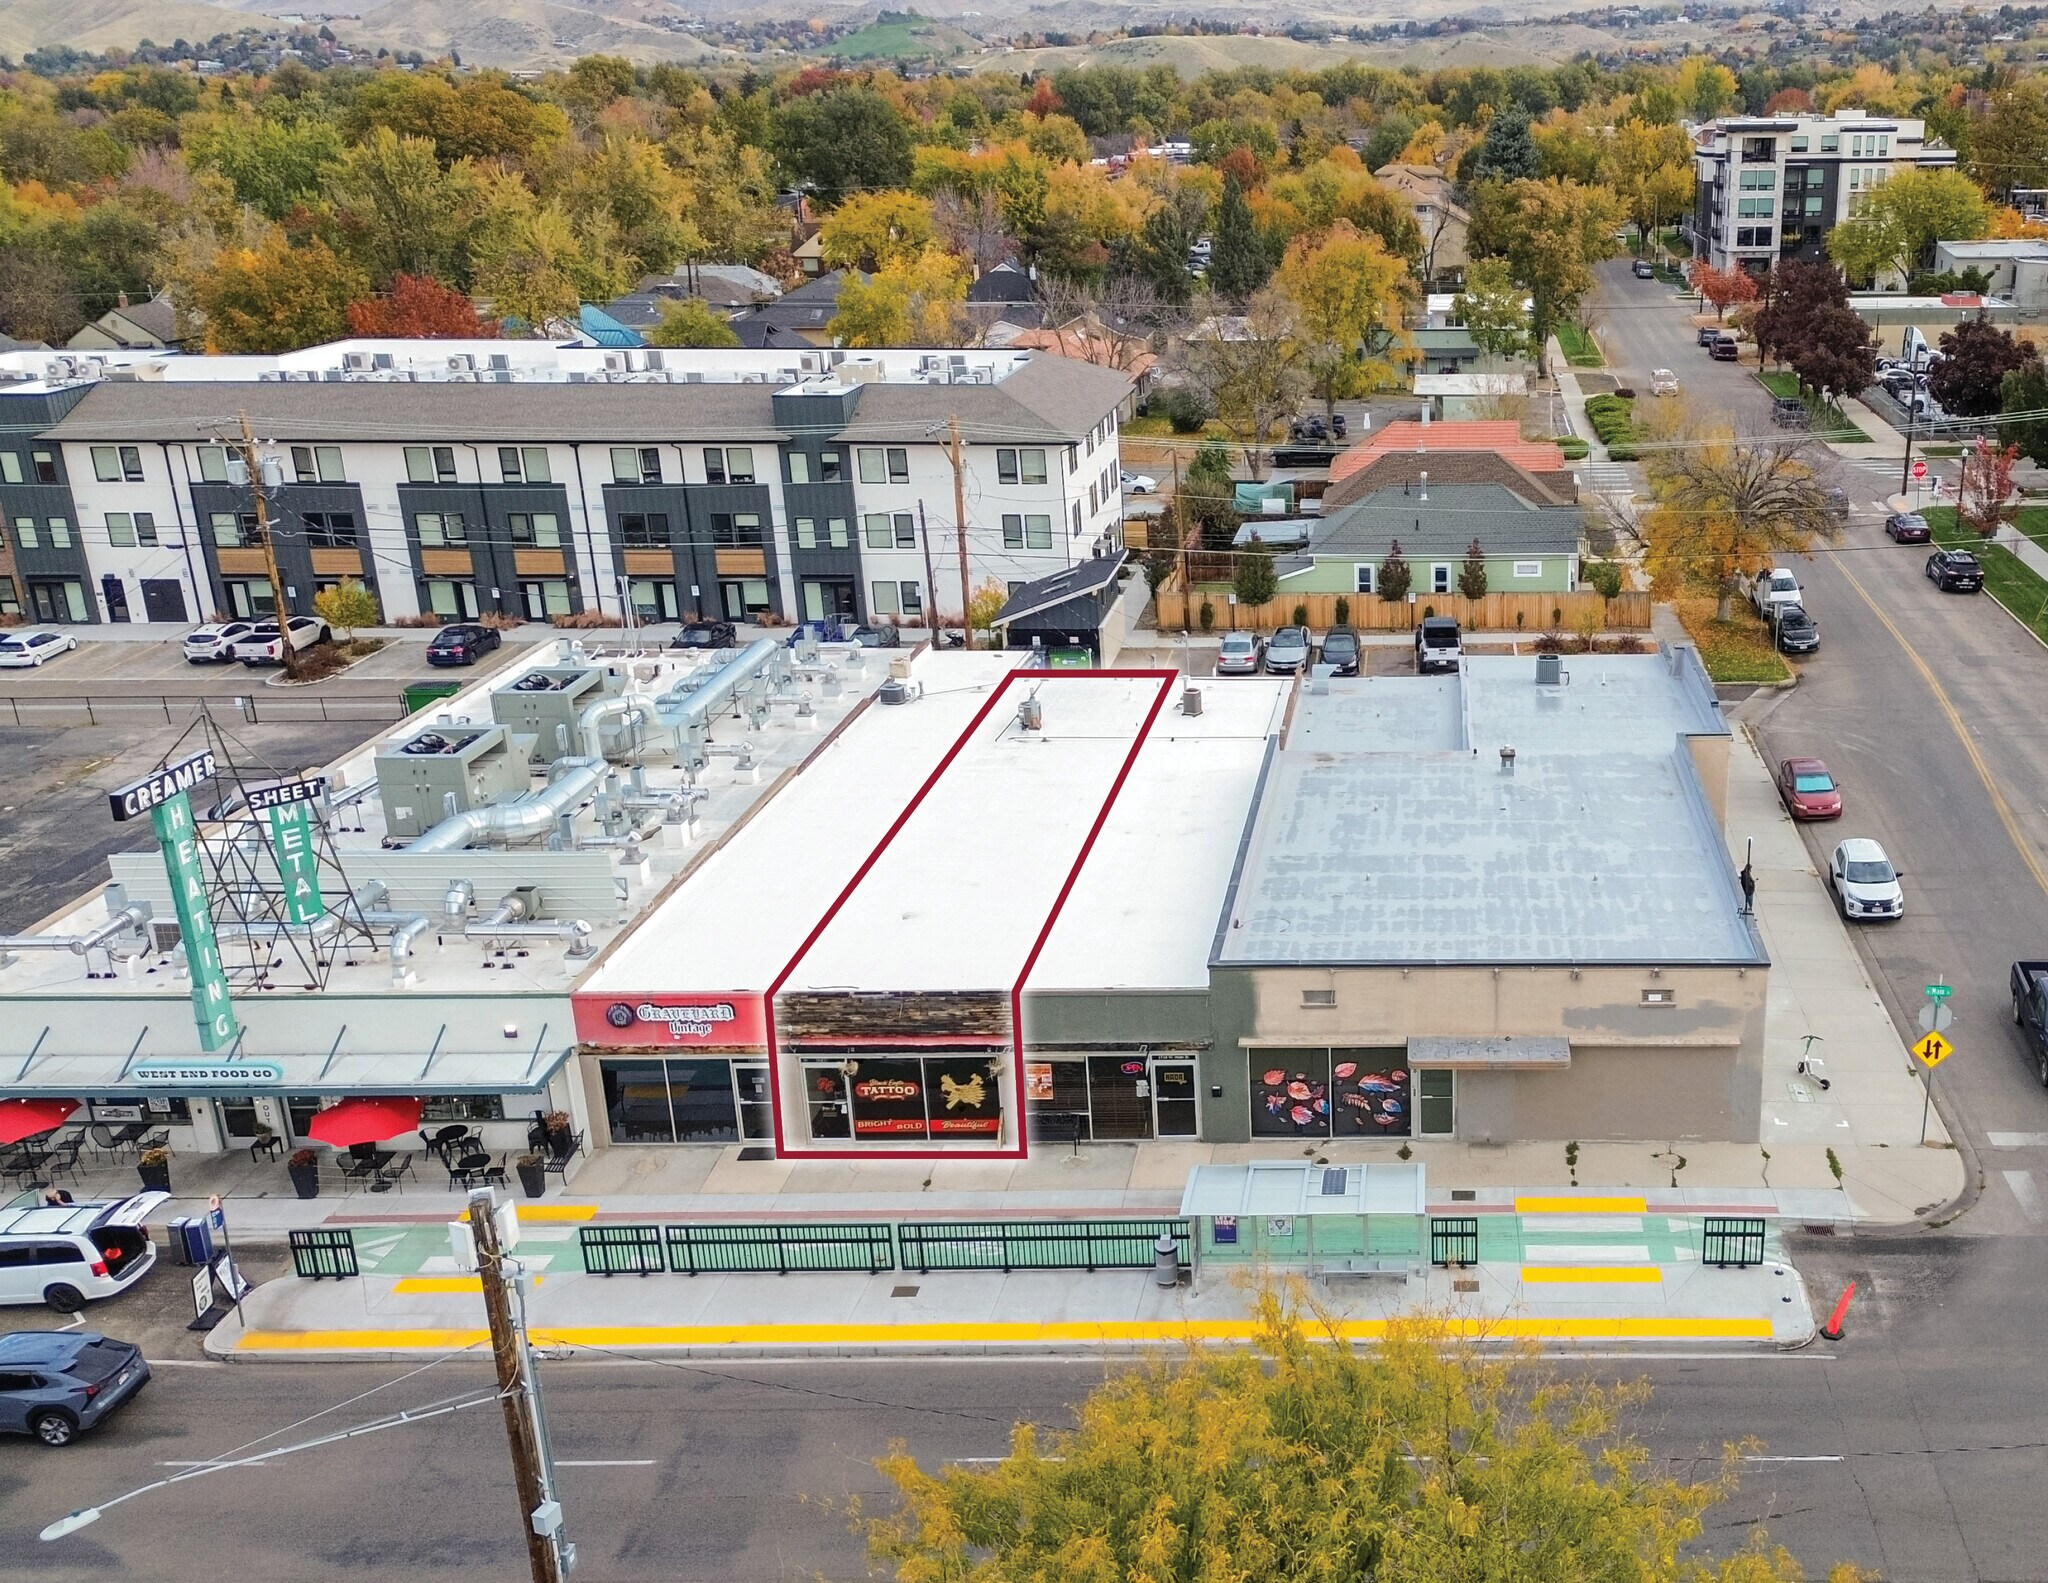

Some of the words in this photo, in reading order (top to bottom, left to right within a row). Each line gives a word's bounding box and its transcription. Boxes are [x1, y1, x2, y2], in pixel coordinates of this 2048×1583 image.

[124, 754, 217, 816] CREAMER
[250, 780, 319, 809] SHEET
[277, 803, 319, 922] METAL
[169, 802, 230, 1037] HEATING
[638, 1005, 733, 1021] GRAVEYARD
[669, 1021, 713, 1036] Vintage
[137, 1070, 176, 1079] WEST
[180, 1070, 209, 1079] END
[211, 1070, 249, 1079] FOOD
[252, 1070, 272, 1078] CO
[860, 1086, 915, 1096] TATTOO
[857, 1120, 893, 1128] BRIGHT
[896, 1122, 923, 1130] BOLD
[941, 1120, 989, 1130] Beautiful
